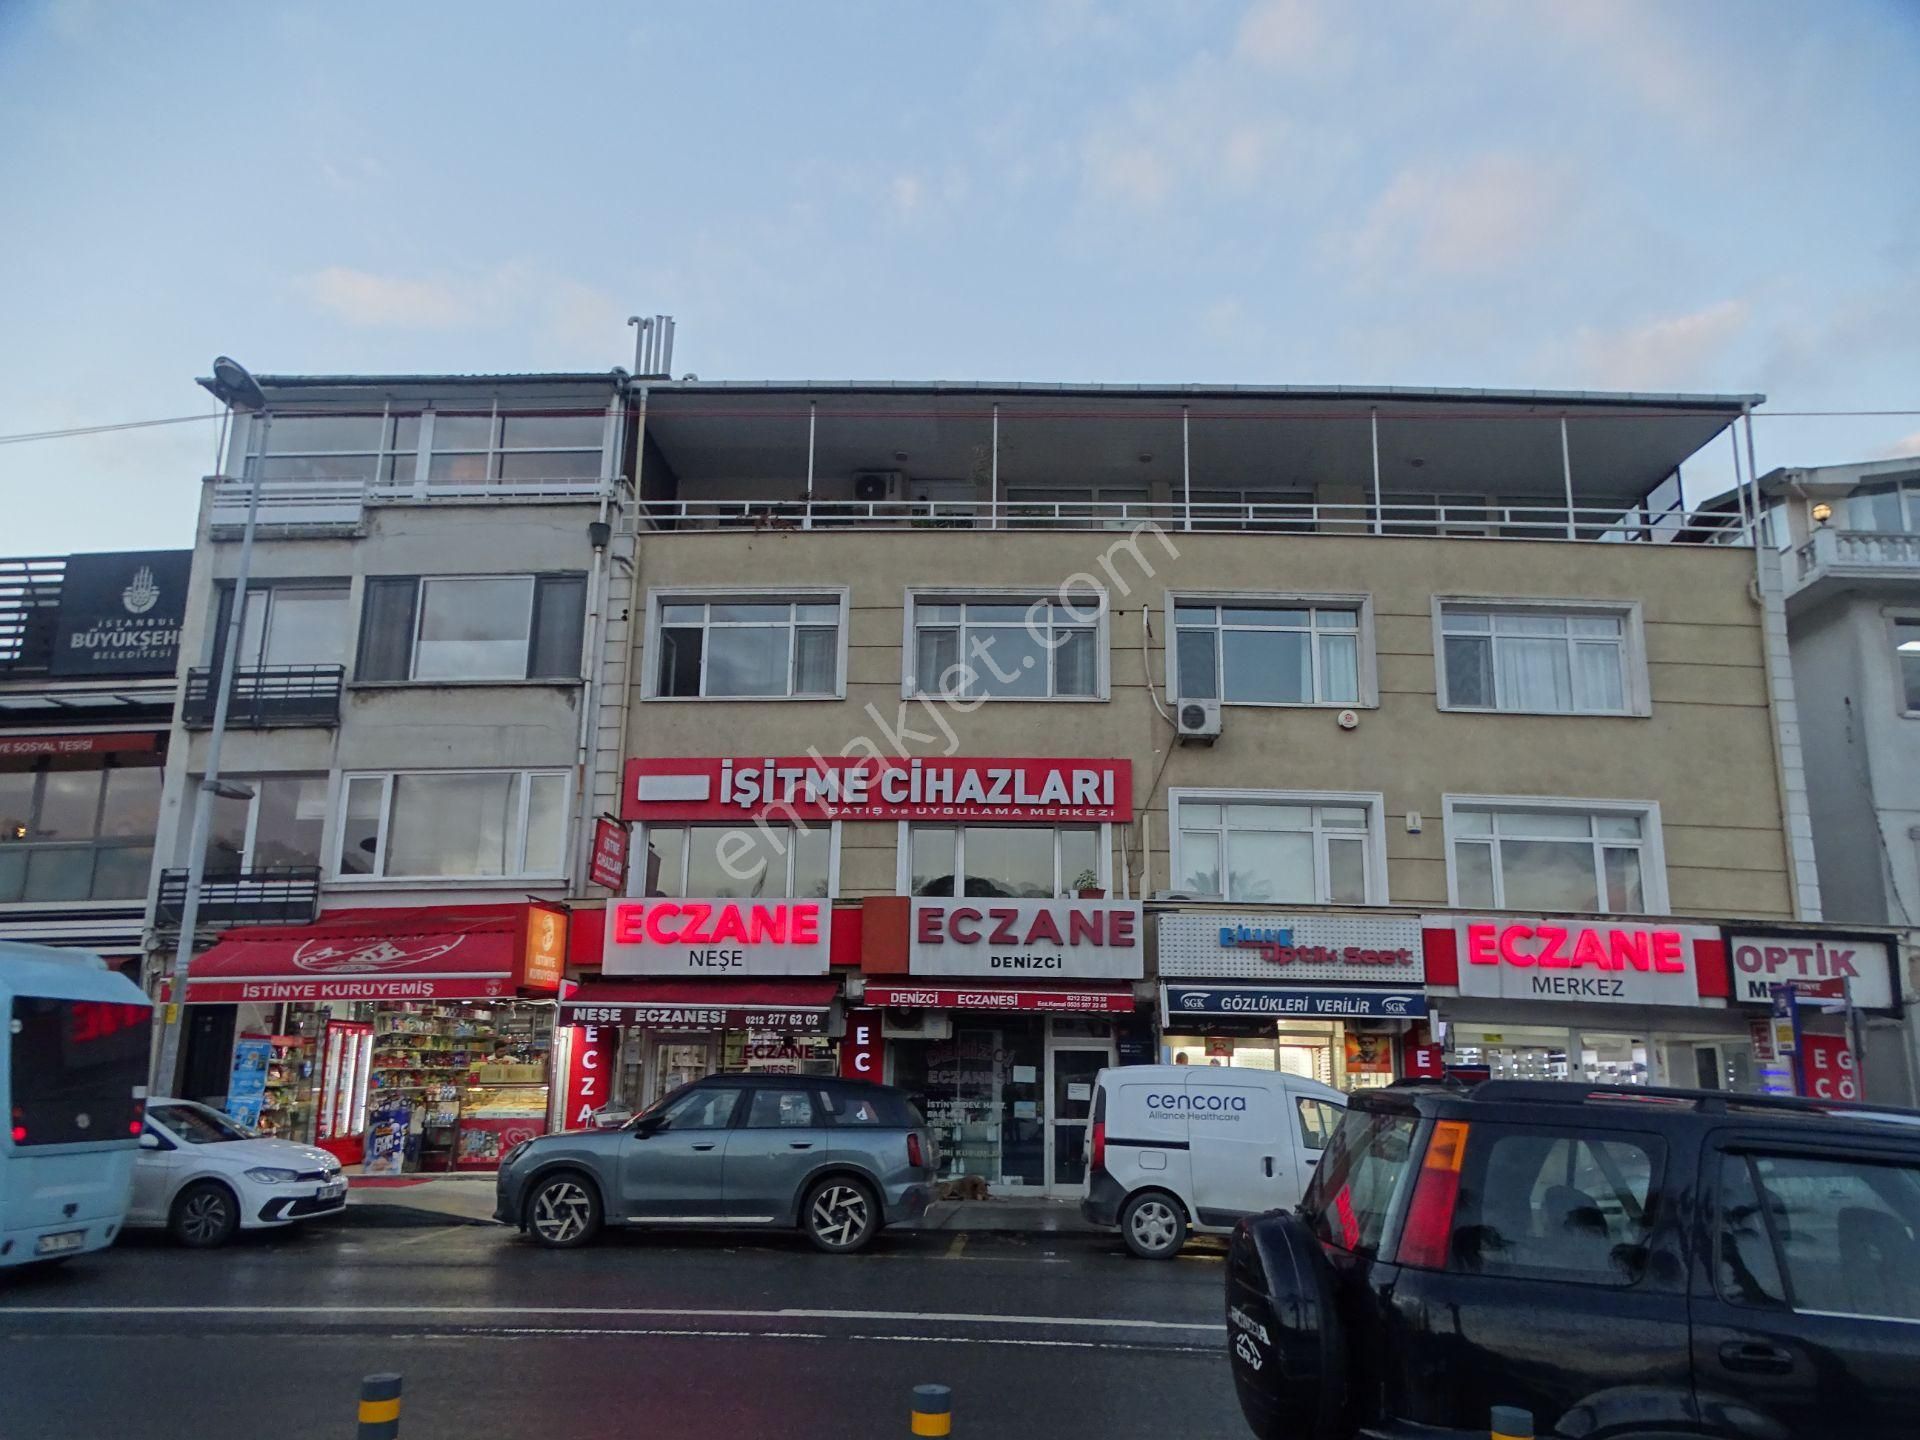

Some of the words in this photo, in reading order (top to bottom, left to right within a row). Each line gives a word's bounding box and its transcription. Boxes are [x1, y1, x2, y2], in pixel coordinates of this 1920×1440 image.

[92, 649, 172, 660] BELEDİYESİ
[13, 741, 56, 752] SOSYAL
[720, 758, 869, 808] İŞİTME
[881, 758, 1115, 805] CİHAZLARI
[827, 807, 883, 815] SATIŞ
[916, 807, 1022, 816] UYGULAMA
[615, 903, 819, 944] ECZANE
[917, 907, 1136, 946] ECZANE
[1468, 923, 1685, 972] ECZANE
[689, 949, 743, 971] NEŞE
[990, 954, 1063, 969] DENİZCİ
[1735, 942, 1860, 977] OPTİK
[242, 983, 315, 998] İSTİNYE
[321, 980, 434, 997] KURUYEMİŞ
[1532, 976, 1625, 997] MERKEZ
[890, 990, 938, 1004] DENİZCİ
[957, 994, 1018, 1006] ECZANESİ
[1183, 999, 1205, 1009] SGK
[1221, 996, 1309, 1012] GÖZLÜKLERİ
[1316, 997, 1370, 1014] VERİLİR
[1385, 1002, 1406, 1013] SGK
[634, 1009, 726, 1023] ECZANESİ
[745, 1014, 764, 1025] 0212
[767, 1013, 786, 1025] 277
[789, 1014, 803, 1026] 62
[805, 1015, 818, 1026] 02
[743, 1044, 815, 1059] ECZANE
[1146, 1094, 1246, 1111] cencora
[1149, 1111, 1186, 1120] Alliance
[1187, 1112, 1240, 1121] Healthcare
